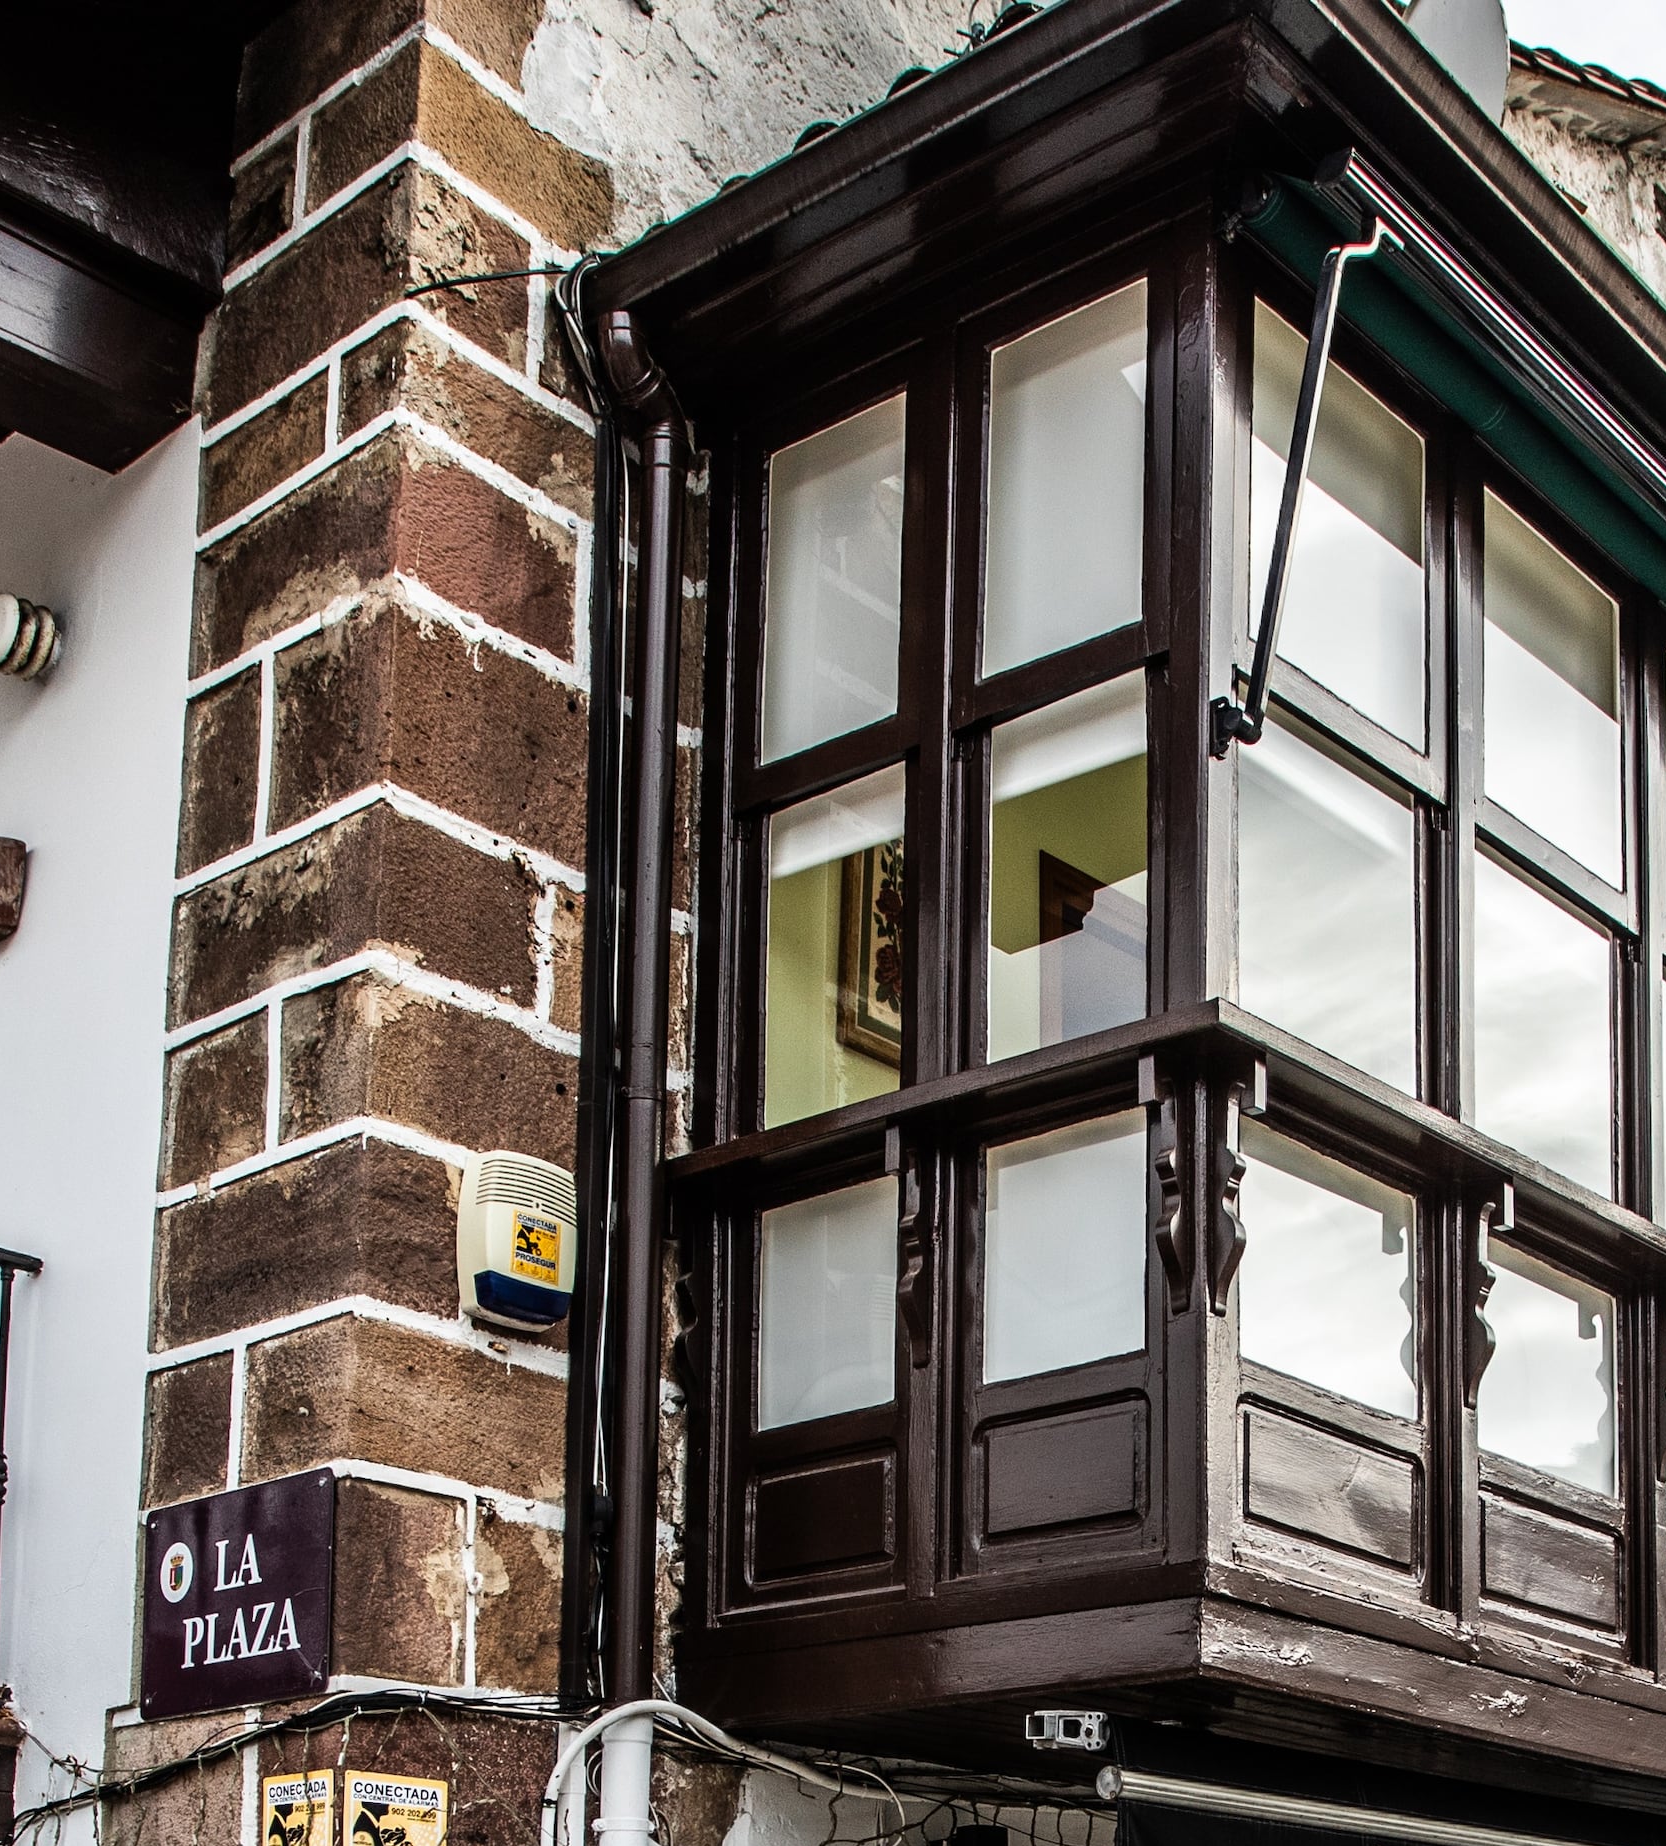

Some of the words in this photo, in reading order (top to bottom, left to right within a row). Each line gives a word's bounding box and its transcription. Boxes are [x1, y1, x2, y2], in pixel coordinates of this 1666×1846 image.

[517, 1214, 557, 1230] CONECTADA
[515, 1252, 556, 1270] PROSEGUR
[214, 1534, 262, 1592] LA
[181, 1598, 301, 1669] PLAZA
[354, 1782, 439, 1801] CONECTADA
[368, 1795, 396, 1804] CENTRAL
[408, 1799, 439, 1808] ALARMAS
[391, 1807, 405, 1816] 902
[407, 1809, 421, 1818] 202
